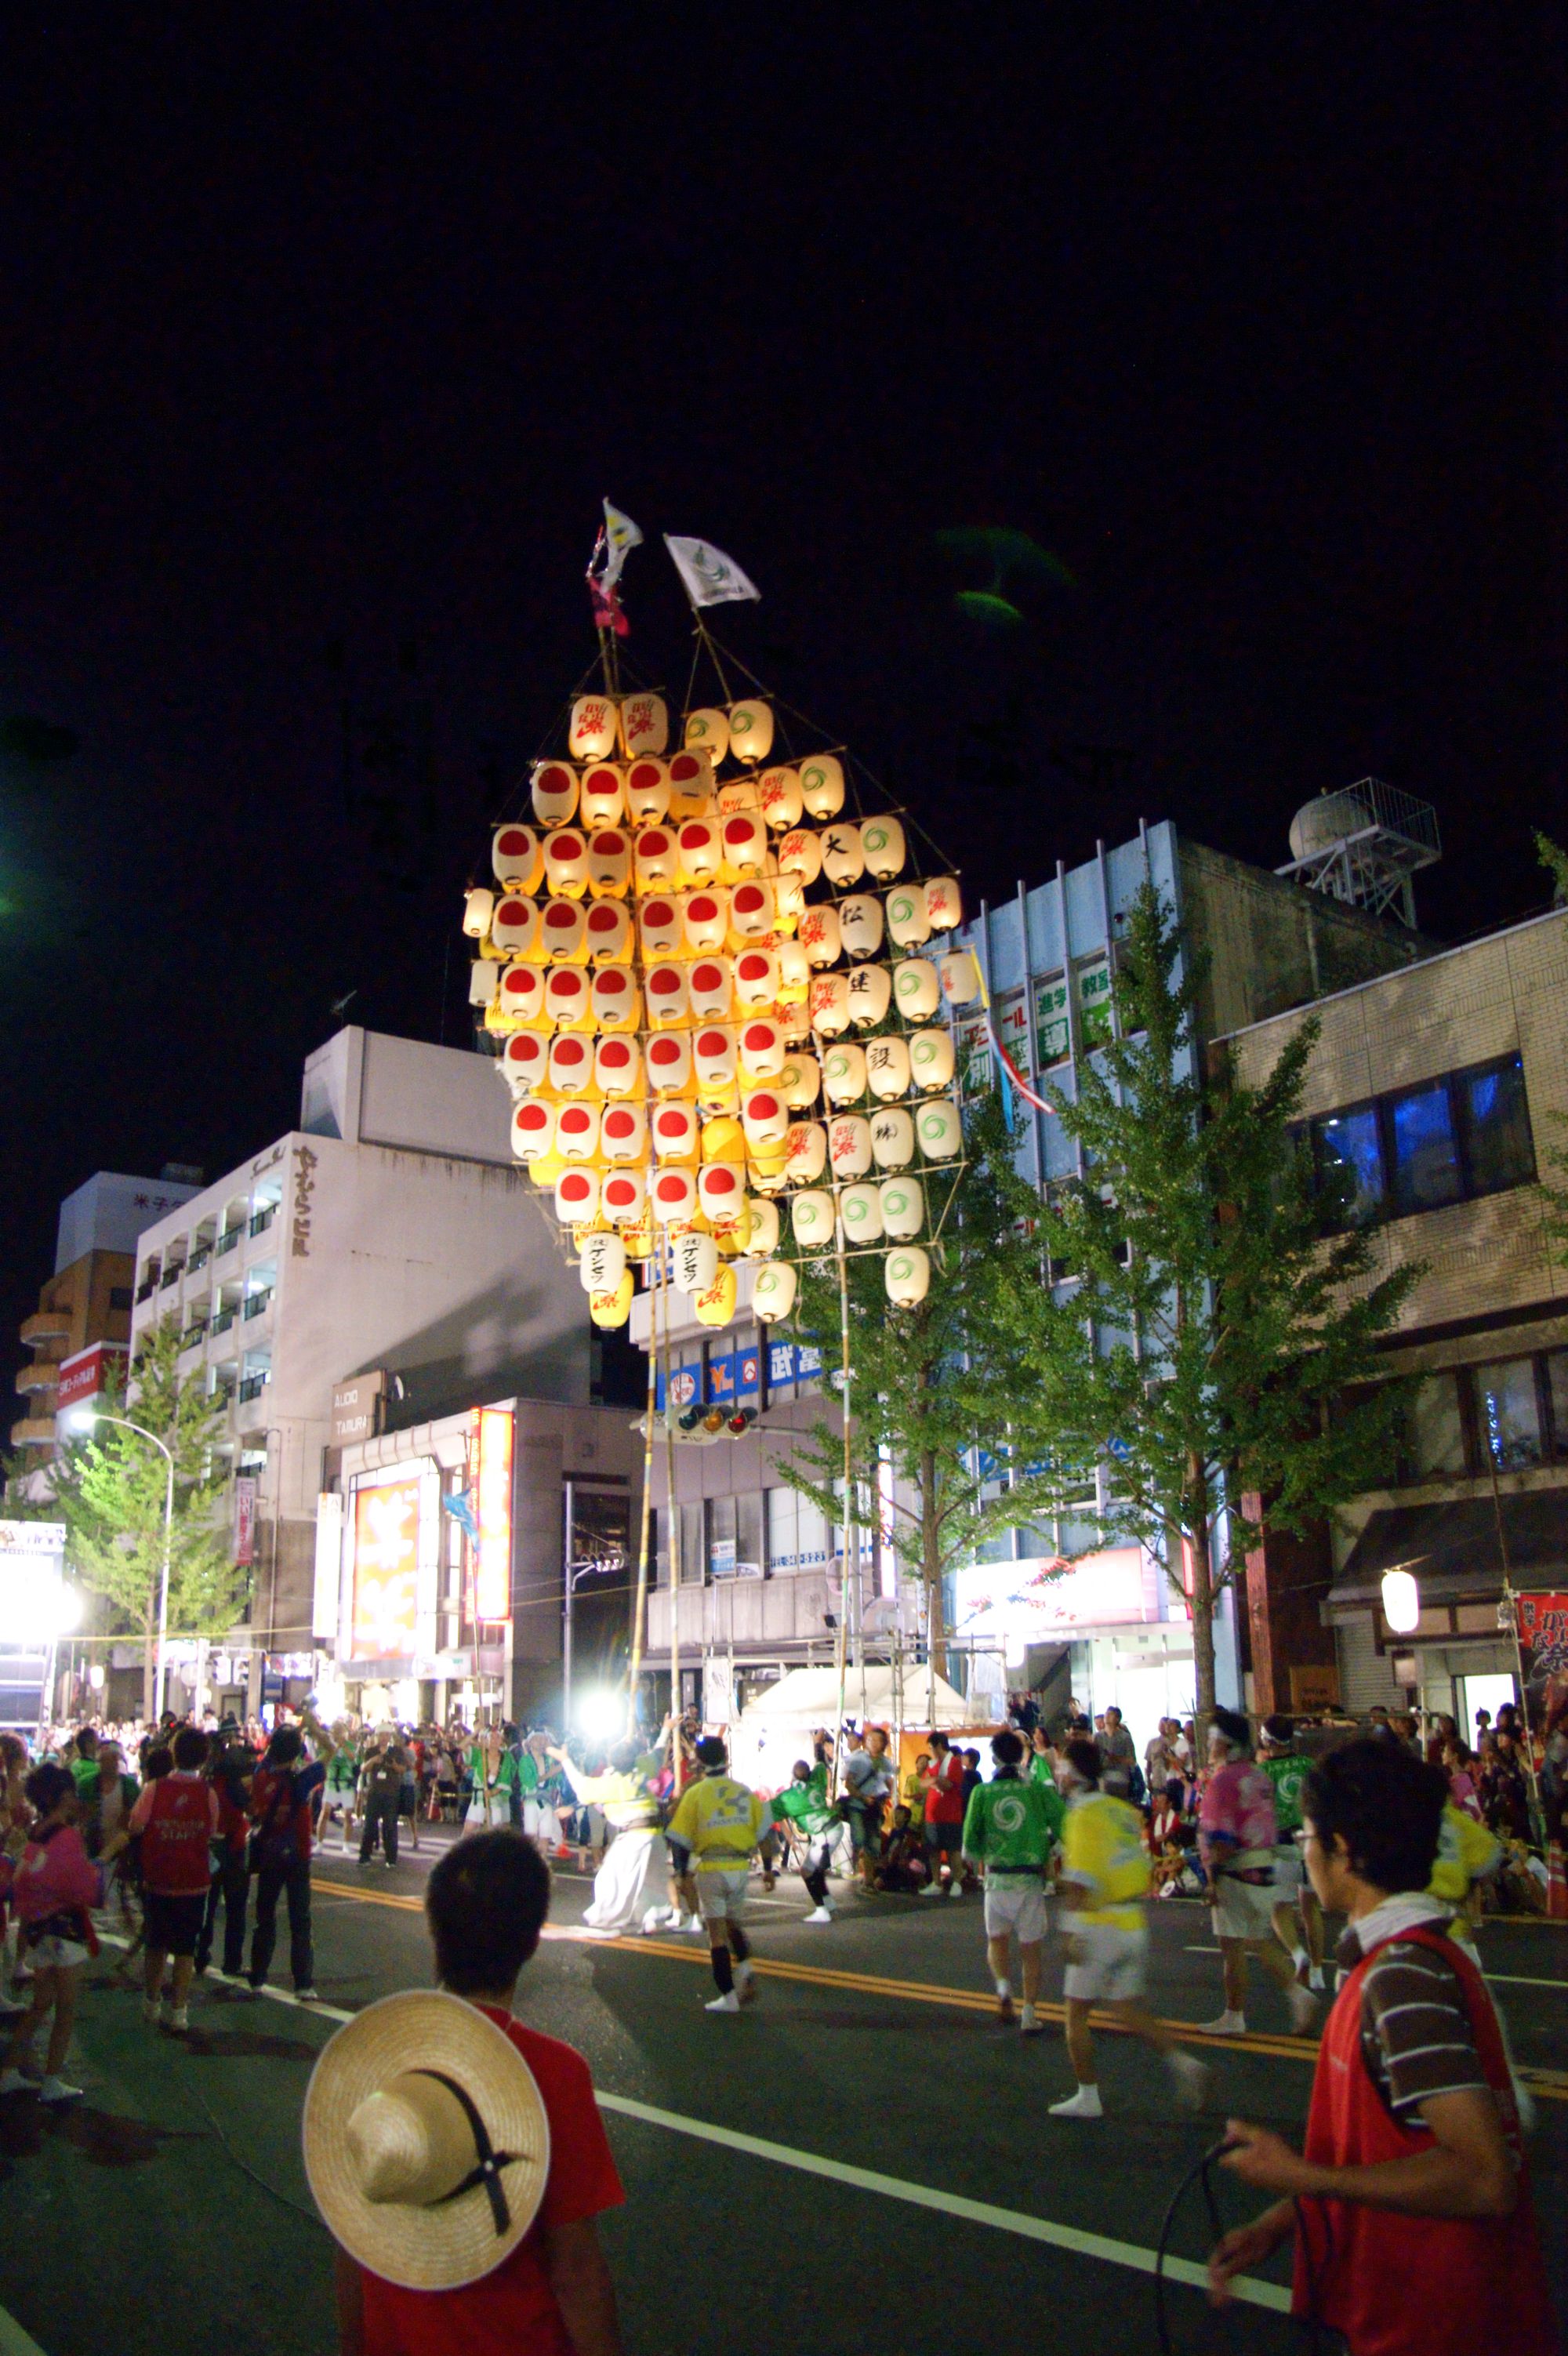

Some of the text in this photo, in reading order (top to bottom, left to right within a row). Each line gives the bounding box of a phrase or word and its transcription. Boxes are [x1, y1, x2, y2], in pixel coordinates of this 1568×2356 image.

[825, 833, 850, 859] 大
[848, 971, 871, 997] 建
[869, 1047, 897, 1071] 設
[334, 1389, 358, 1408] AUDIO
[336, 1414, 367, 1435] TAMURA
